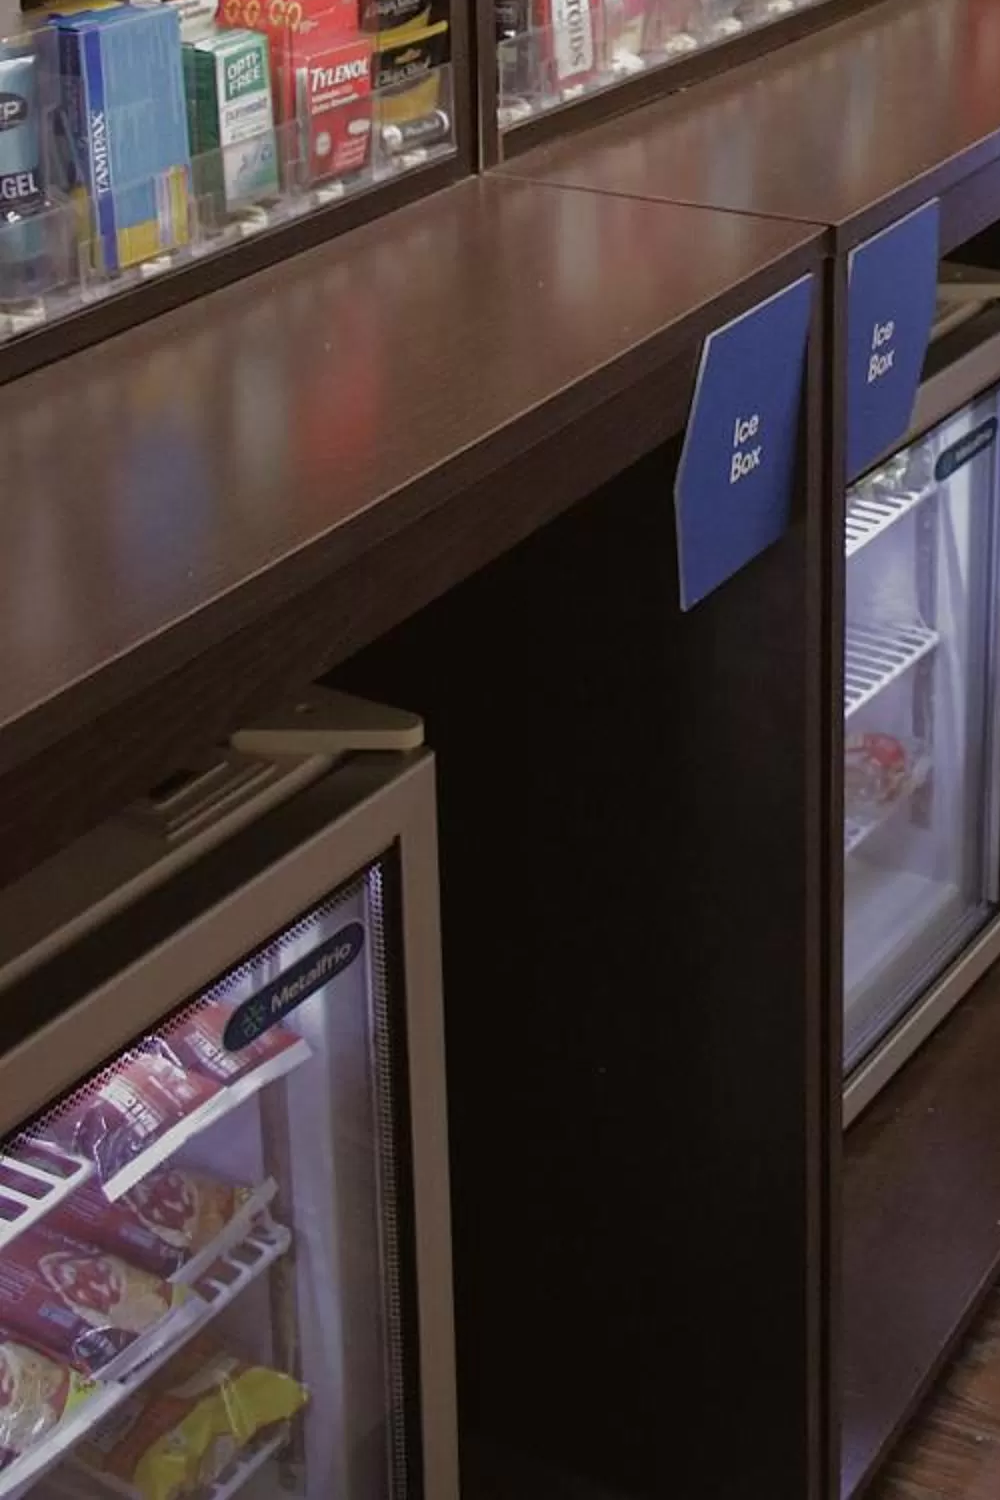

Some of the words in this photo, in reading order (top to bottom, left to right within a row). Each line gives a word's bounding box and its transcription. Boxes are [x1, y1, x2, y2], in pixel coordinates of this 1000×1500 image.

[229, 66, 262, 96] FREE
[310, 57, 370, 92] TYLENOL
[91, 111, 111, 193] TAMPAX
[1, 172, 39, 199] GEL
[871, 320, 894, 349] Ice
[866, 350, 896, 384] Box
[733, 413, 759, 447] Ice
[729, 443, 762, 485] Box
